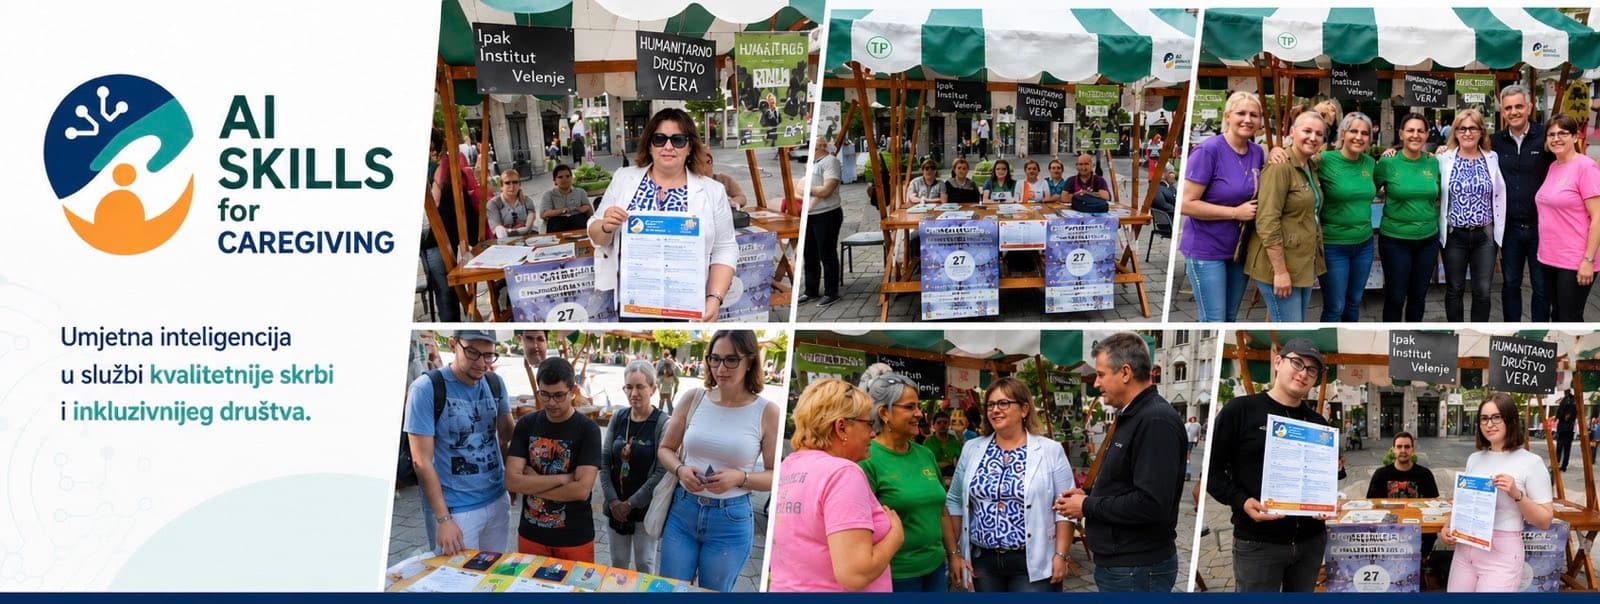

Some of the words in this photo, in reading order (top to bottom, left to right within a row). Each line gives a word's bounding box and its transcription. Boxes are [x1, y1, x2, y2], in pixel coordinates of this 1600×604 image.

[478, 29, 511, 46] Ipak
[1279, 36, 1295, 46] TP
[640, 36, 713, 58] HUMANITARNO
[871, 42, 889, 54] TP
[480, 47, 536, 63] Institut
[653, 56, 705, 75] DRUŠTVO
[512, 69, 565, 87] Velenje
[658, 74, 698, 93] VERA
[1029, 107, 1053, 118] VERA
[952, 256, 966, 266] 27
[1073, 253, 1086, 262] 27
[557, 308, 574, 322] 27
[1392, 333, 1416, 346] Ipak
[1392, 348, 1432, 360] Institut
[1411, 362, 1450, 377] Velenje
[1501, 355, 1546, 373] DRUŠTVO
[1505, 370, 1539, 386] VERA
[1363, 571, 1379, 582] 27
